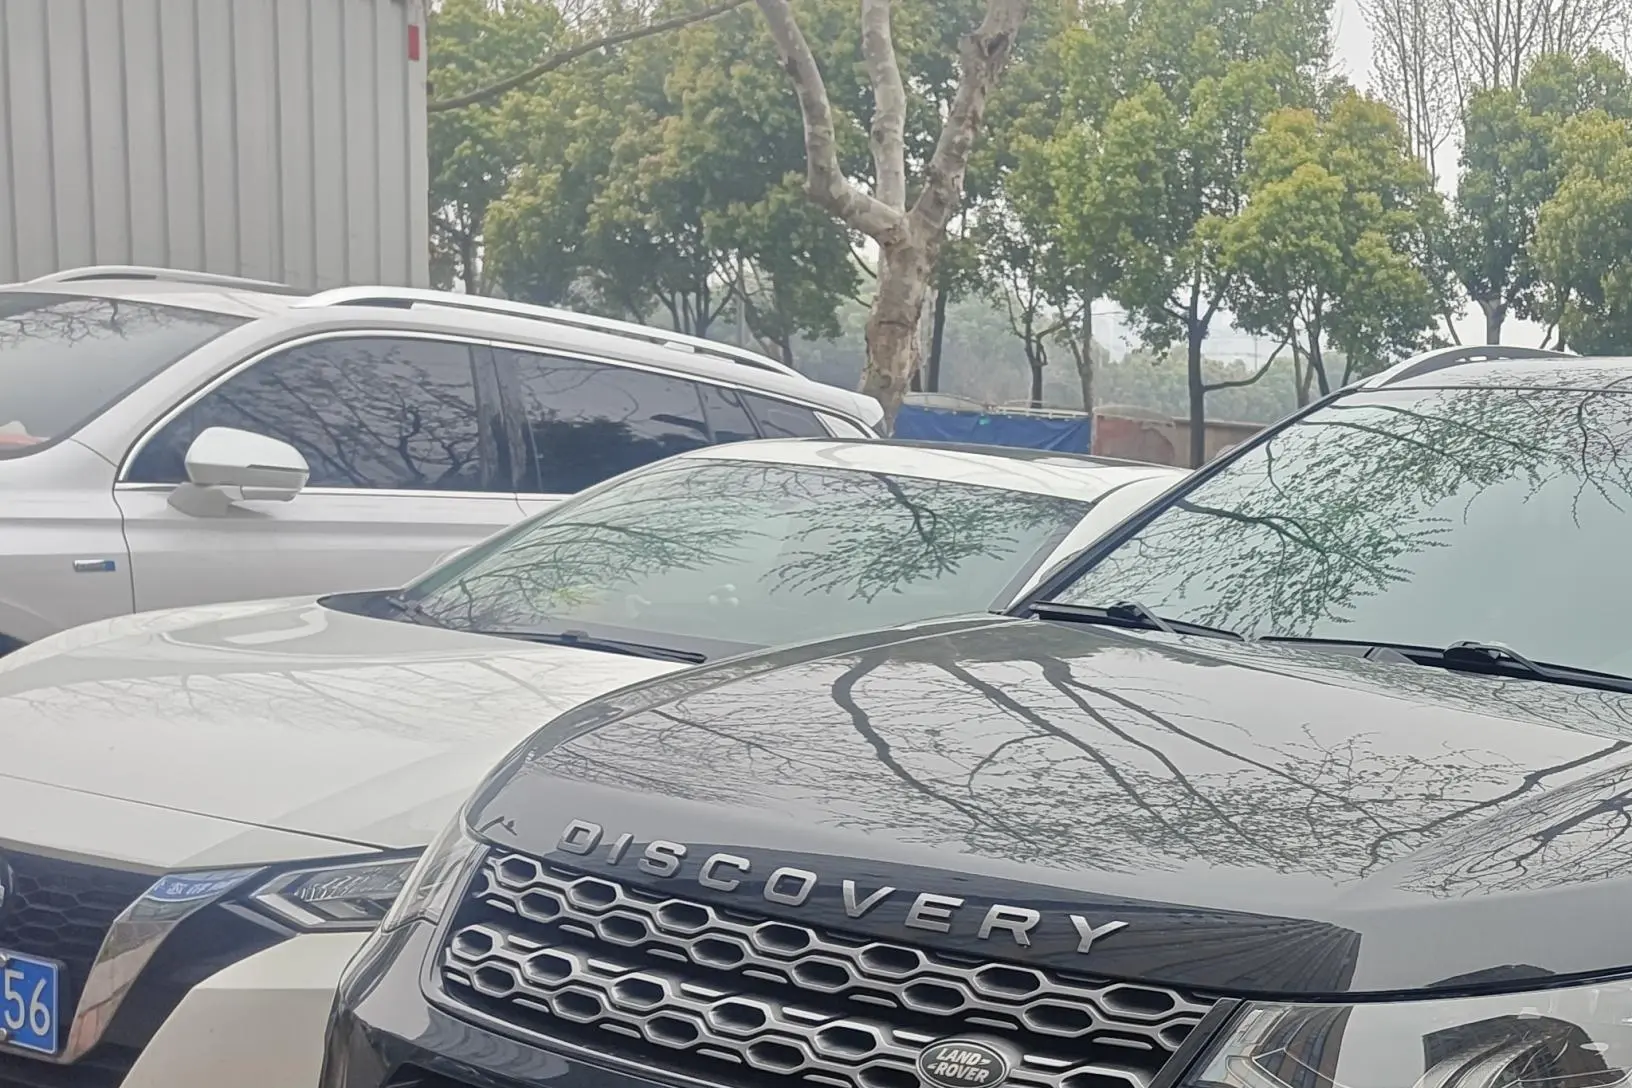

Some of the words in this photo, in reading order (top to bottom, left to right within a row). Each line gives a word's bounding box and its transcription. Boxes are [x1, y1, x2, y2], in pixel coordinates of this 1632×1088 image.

[555, 818, 1129, 954] DISCOVERY
[4, 969, 50, 1036] 56
[933, 1062, 990, 1083] ROVER
[936, 1048, 982, 1066] LAND
